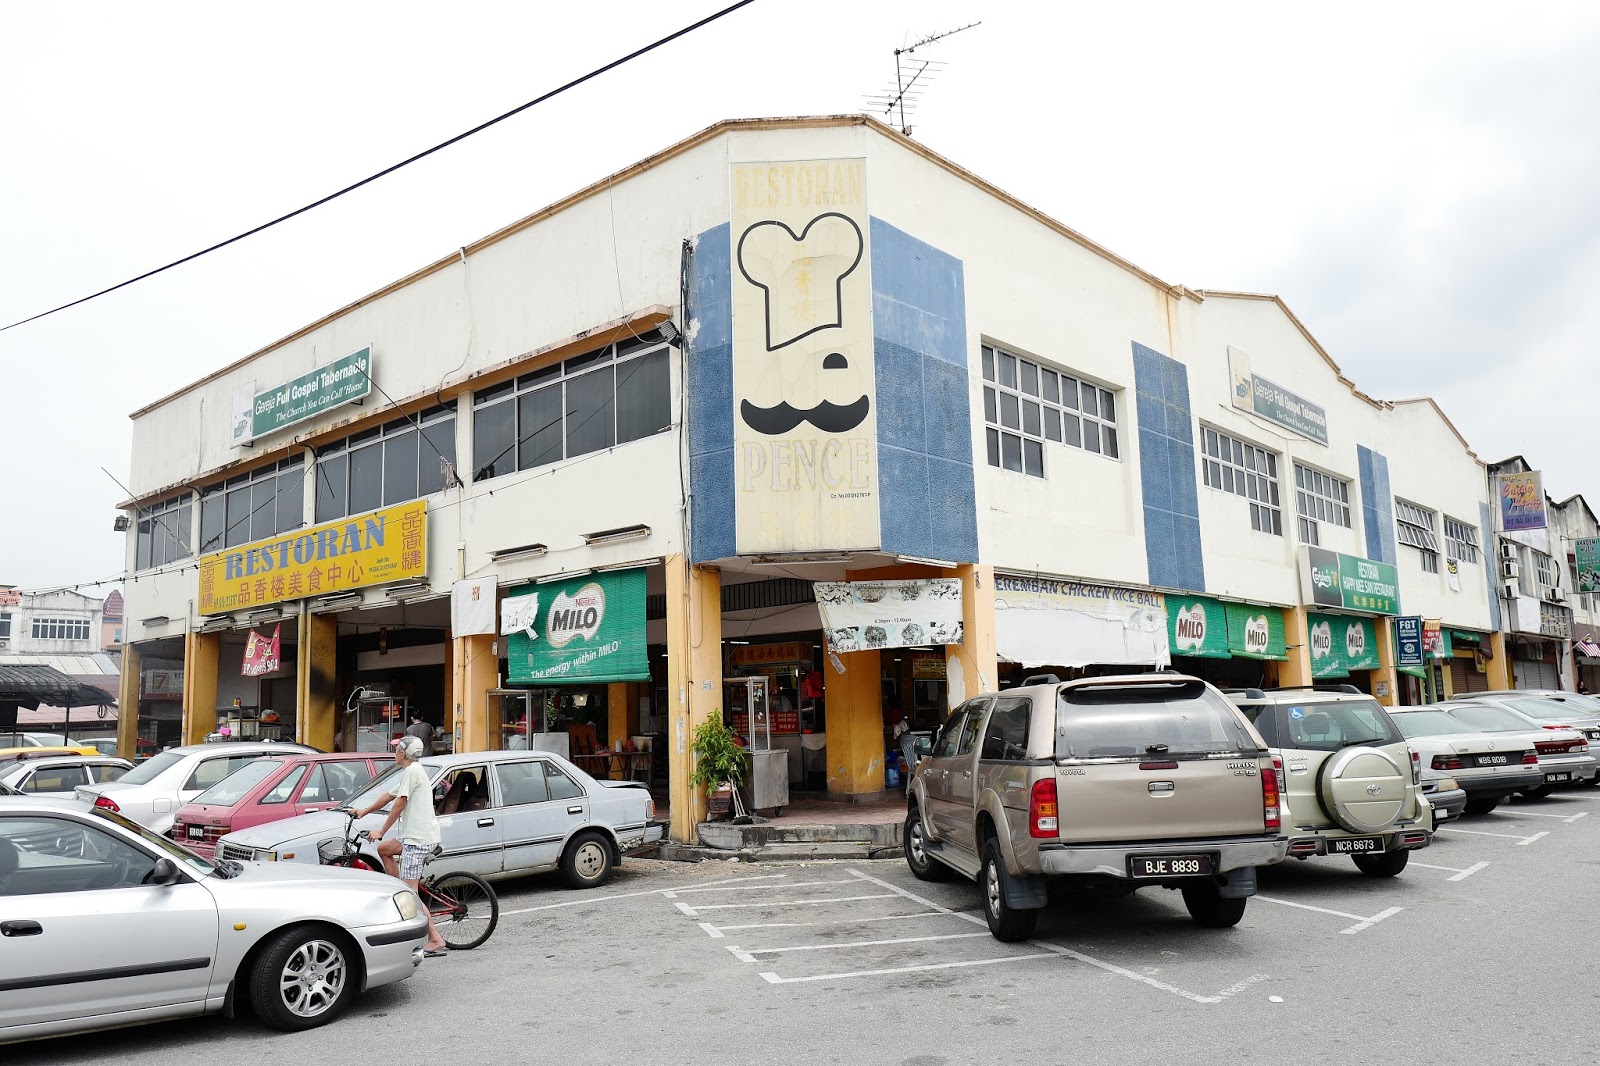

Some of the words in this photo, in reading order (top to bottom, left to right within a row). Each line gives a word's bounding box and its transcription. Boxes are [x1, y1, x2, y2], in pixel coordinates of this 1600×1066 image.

[735, 163, 863, 209] RESTORAN
[255, 395, 275, 415] Gereja
[276, 390, 290, 406] Full
[292, 376, 319, 400] Gospel
[320, 357, 367, 388] Tabernacle
[1254, 379, 1273, 404] Gereja
[1274, 391, 1285, 408] Full
[1284, 396, 1301, 416] Gospel
[276, 412, 286, 423] The
[286, 404, 307, 418] Church
[307, 400, 318, 411] You
[318, 395, 330, 406] Can
[330, 387, 344, 401] Call
[742, 438, 869, 492] PENCE
[225, 516, 386, 581] RESTORAN
[238, 560, 364, 605] 品香楼美食中心
[1358, 561, 1380, 581] RESTORAN
[994, 577, 1058, 594] EREMBAN
[1061, 582, 1110, 600] CHICKEN
[1112, 588, 1135, 603] RICE
[1137, 592, 1162, 608] BALL
[552, 607, 598, 632] MILO
[1178, 619, 1203, 639] MILO
[1399, 620, 1417, 629] FGT
[1248, 630, 1267, 646] MILO
[1314, 634, 1329, 648] MILO
[1348, 634, 1363, 648] MILO
[531, 669, 544, 679] The
[545, 660, 571, 677] energy
[573, 651, 597, 667] within
[598, 640, 620, 657] MILO
[1227, 762, 1255, 770] HILUX
[1335, 841, 1353, 851] NCR
[1353, 840, 1375, 850] 6673
[1145, 860, 1167, 874] BJE
[1171, 859, 1199, 873] 8839
